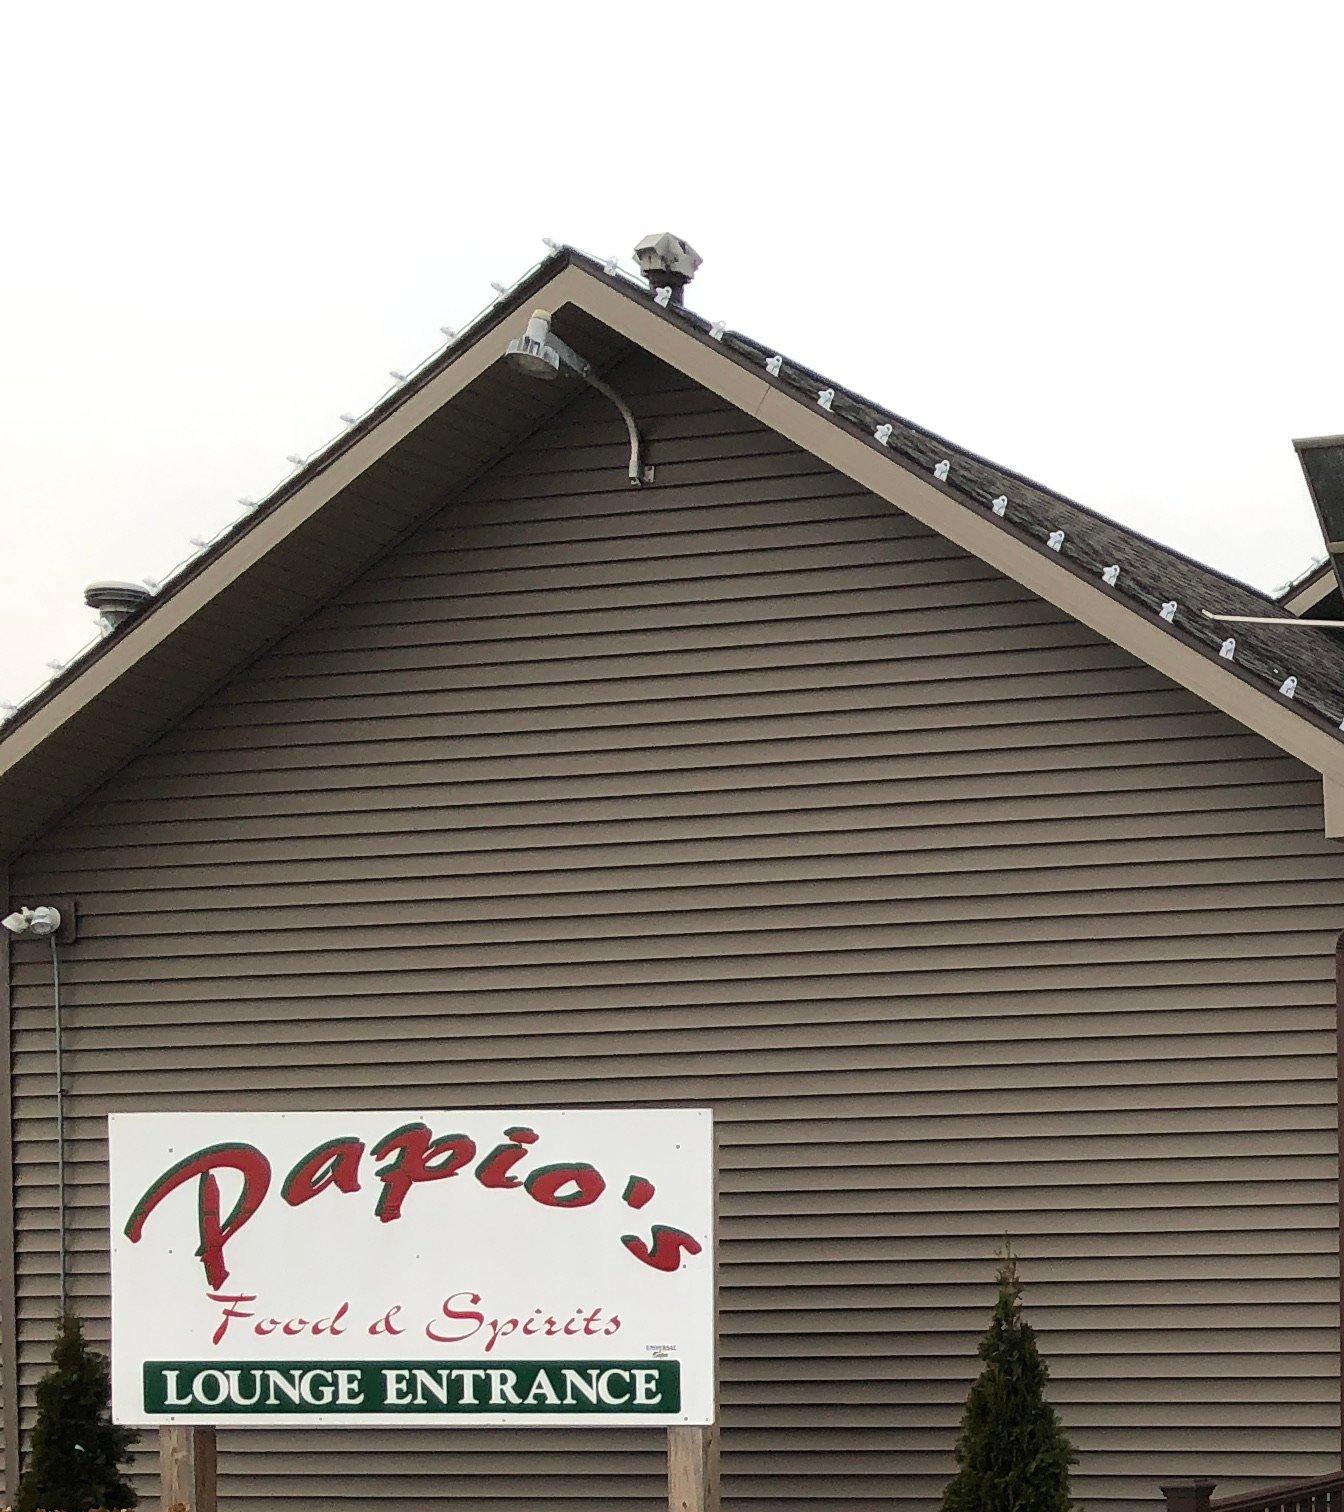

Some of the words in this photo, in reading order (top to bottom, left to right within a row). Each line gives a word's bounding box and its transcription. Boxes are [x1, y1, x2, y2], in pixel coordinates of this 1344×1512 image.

[123, 1122, 703, 1290] Papio's
[206, 1290, 350, 1345] Food
[367, 1307, 407, 1336] &
[425, 1291, 623, 1352] Spirits
[161, 1369, 366, 1406] LOUNGE
[382, 1368, 664, 1406] ENTRANCE
